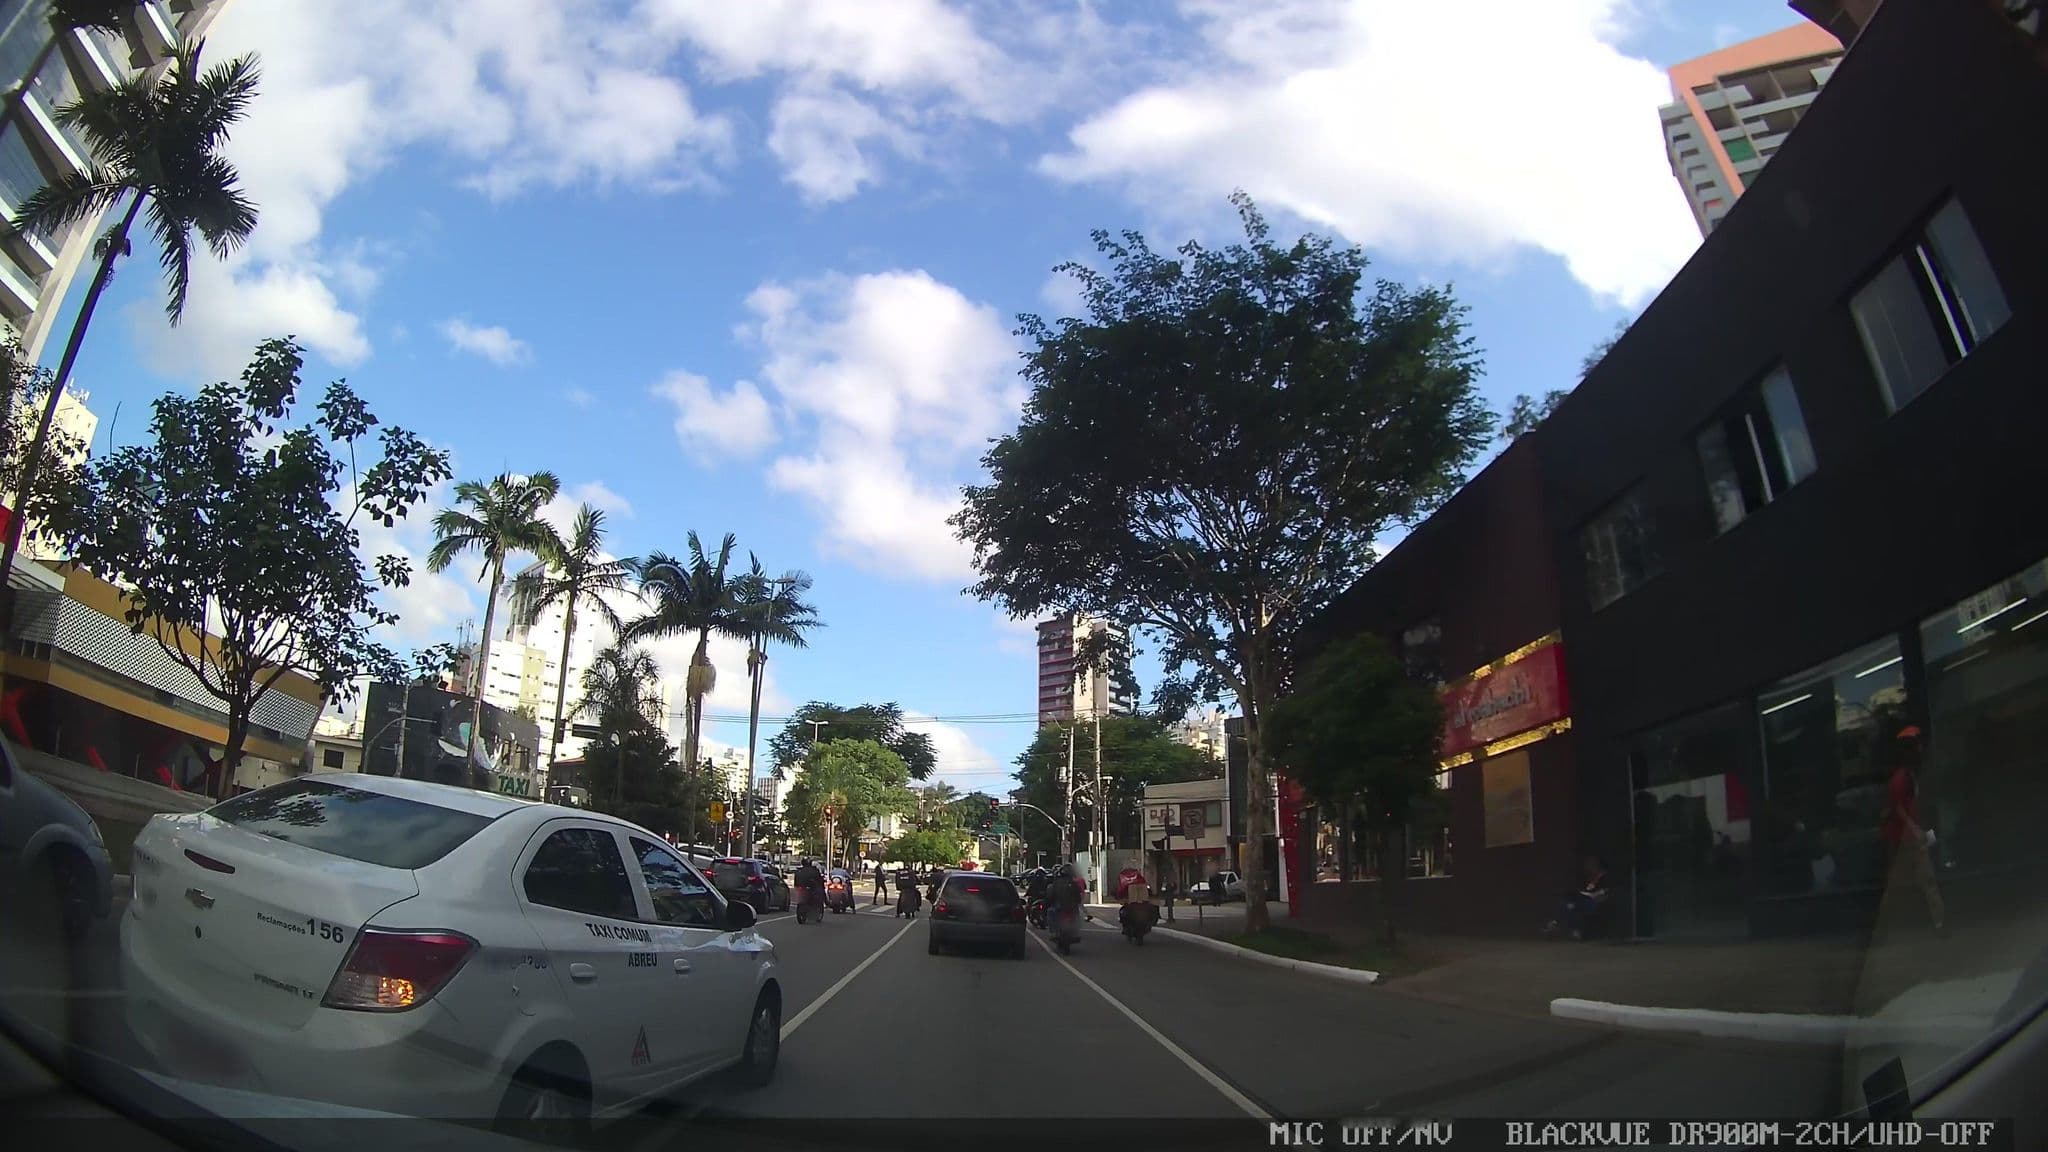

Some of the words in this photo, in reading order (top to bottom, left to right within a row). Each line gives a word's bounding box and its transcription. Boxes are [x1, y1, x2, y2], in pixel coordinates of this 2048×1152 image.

[498, 775, 530, 795] TAXI
[256, 912, 306, 935] Reclamações
[307, 918, 344, 944] 156
[585, 923, 615, 940] TAXI
[614, 926, 653, 943] COMUM
[628, 952, 658, 968] ABREU
